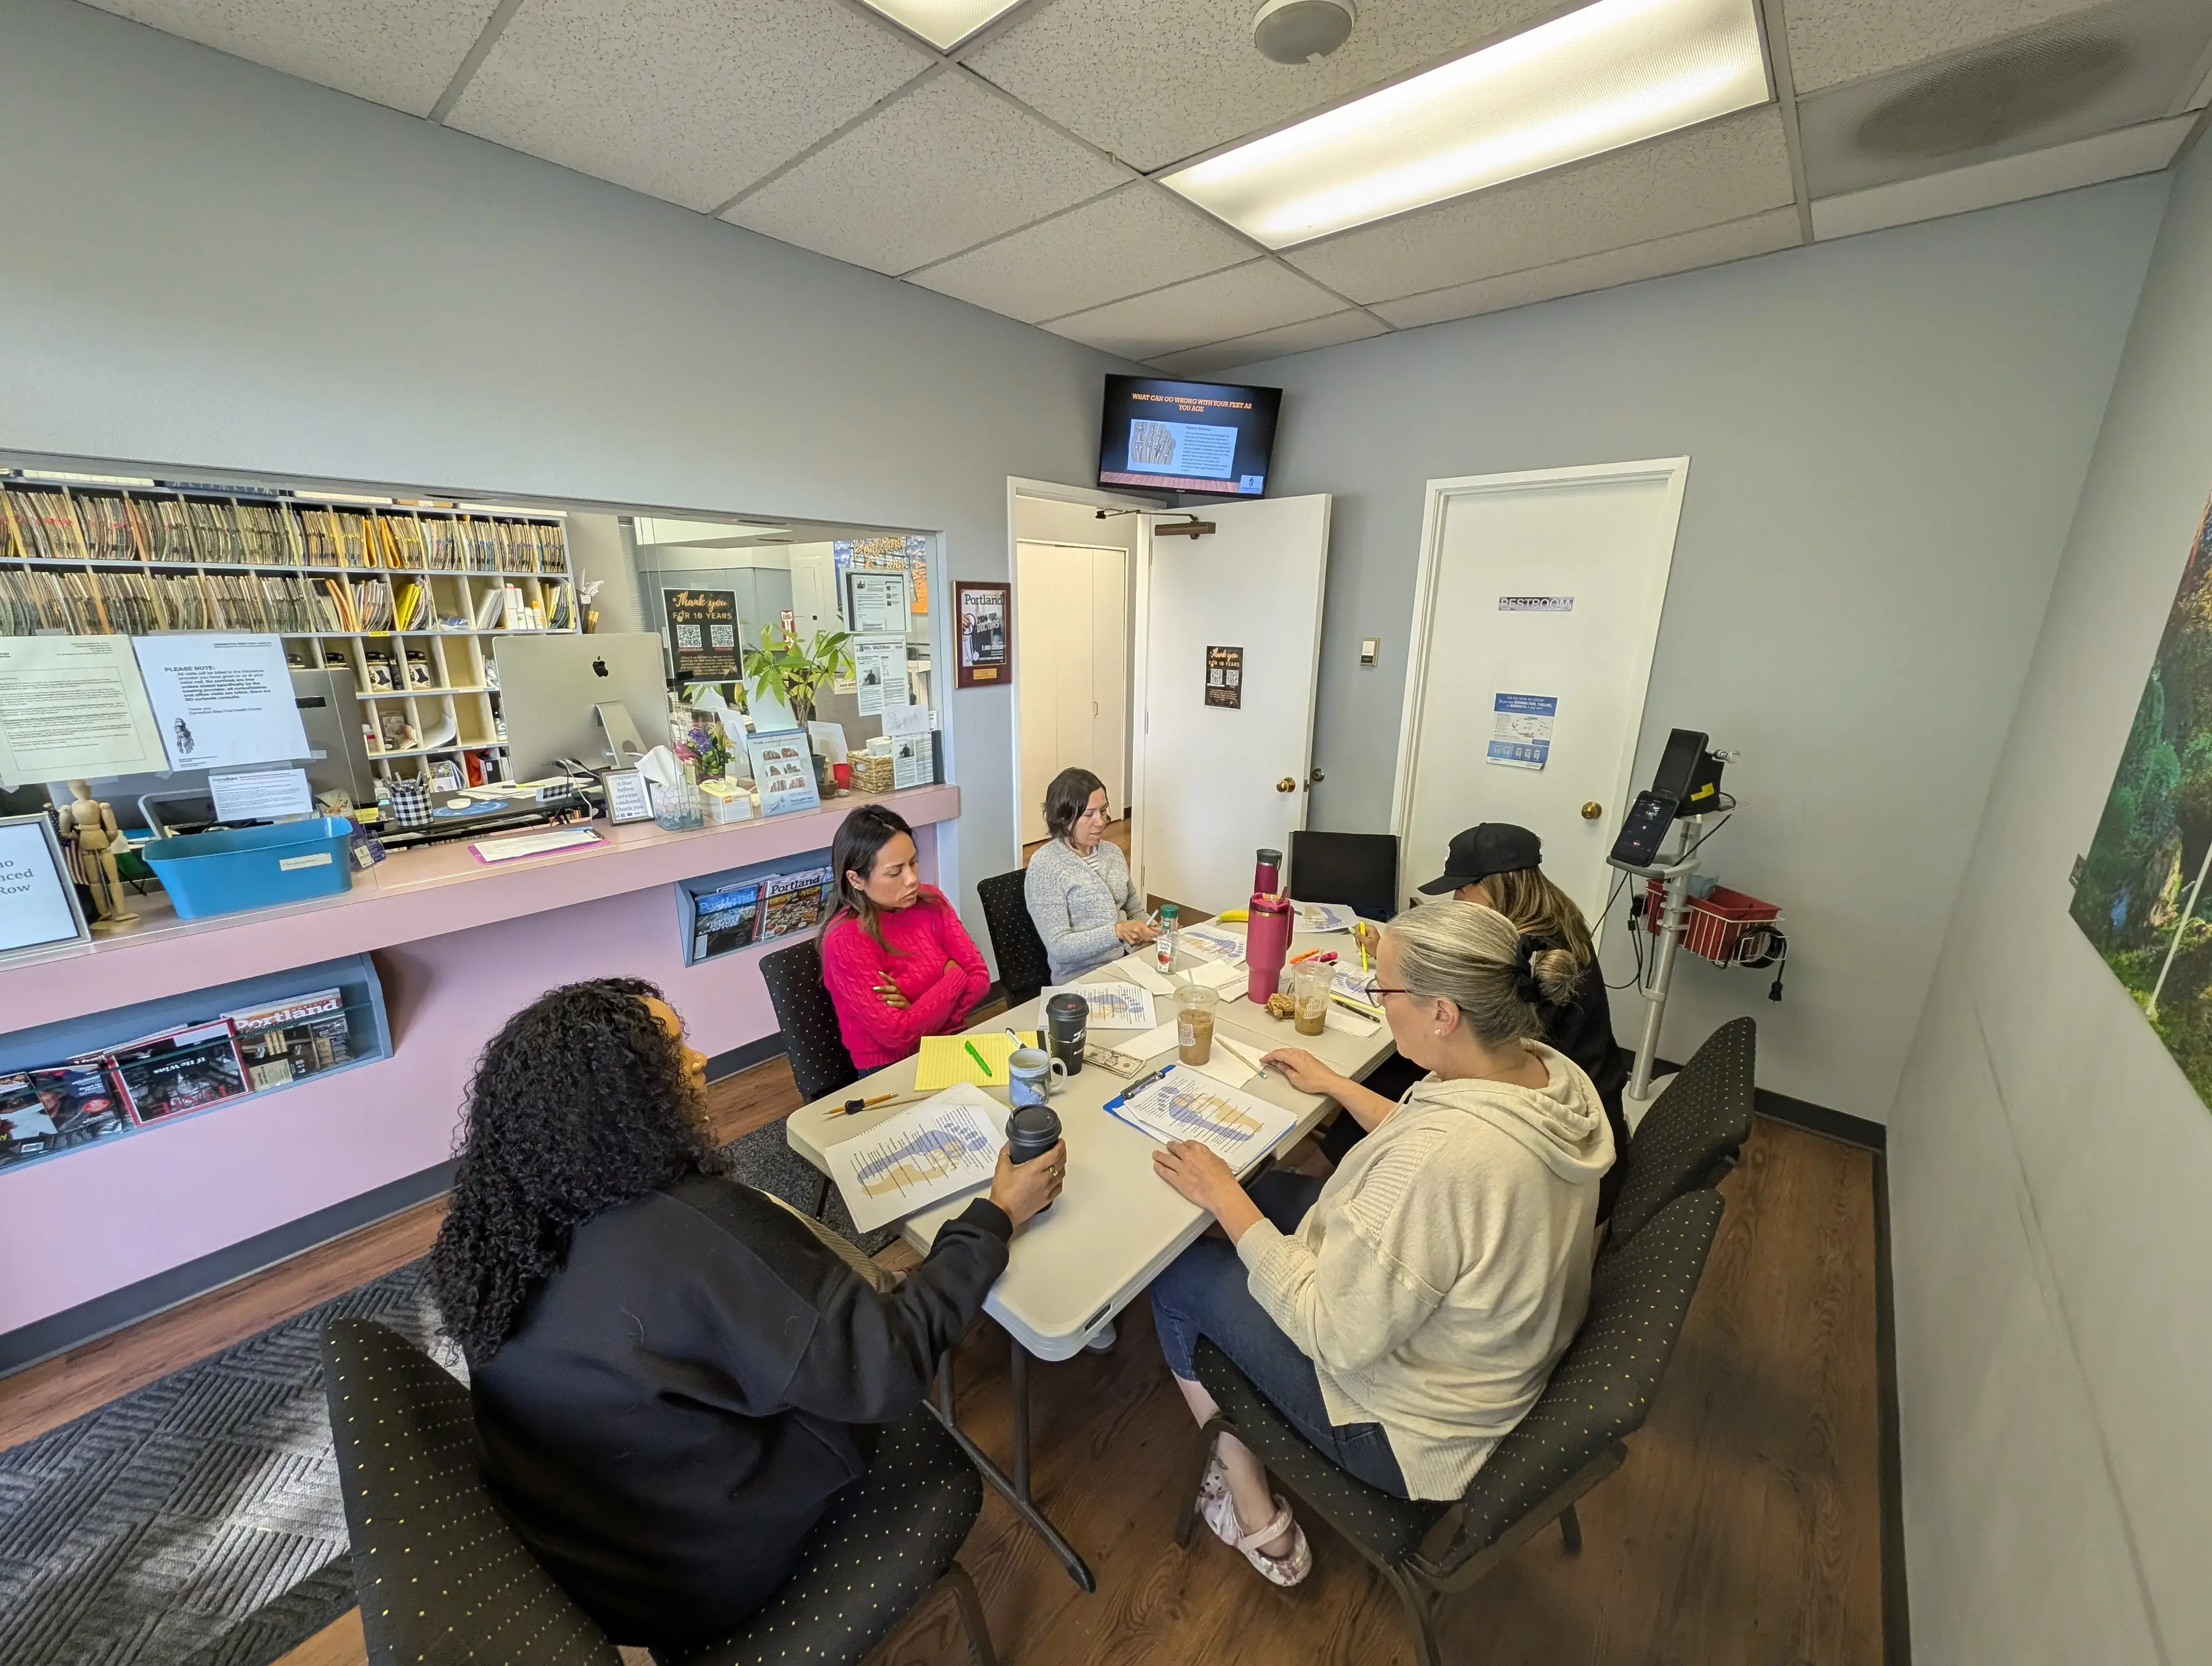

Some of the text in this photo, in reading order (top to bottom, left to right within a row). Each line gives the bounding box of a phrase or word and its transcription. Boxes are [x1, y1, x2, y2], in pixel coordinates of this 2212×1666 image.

[676, 591, 728, 612] Thank you
[964, 594, 1004, 605] Portland
[1501, 598, 1571, 608] RESTROOM
[977, 619, 1000, 633] DOCTORS
[770, 875, 820, 895] Portland
[699, 890, 755, 912] Portland
[235, 999, 339, 1030] Portland
[196, 1057, 207, 1065] If
[153, 1063, 180, 1074] Wins
